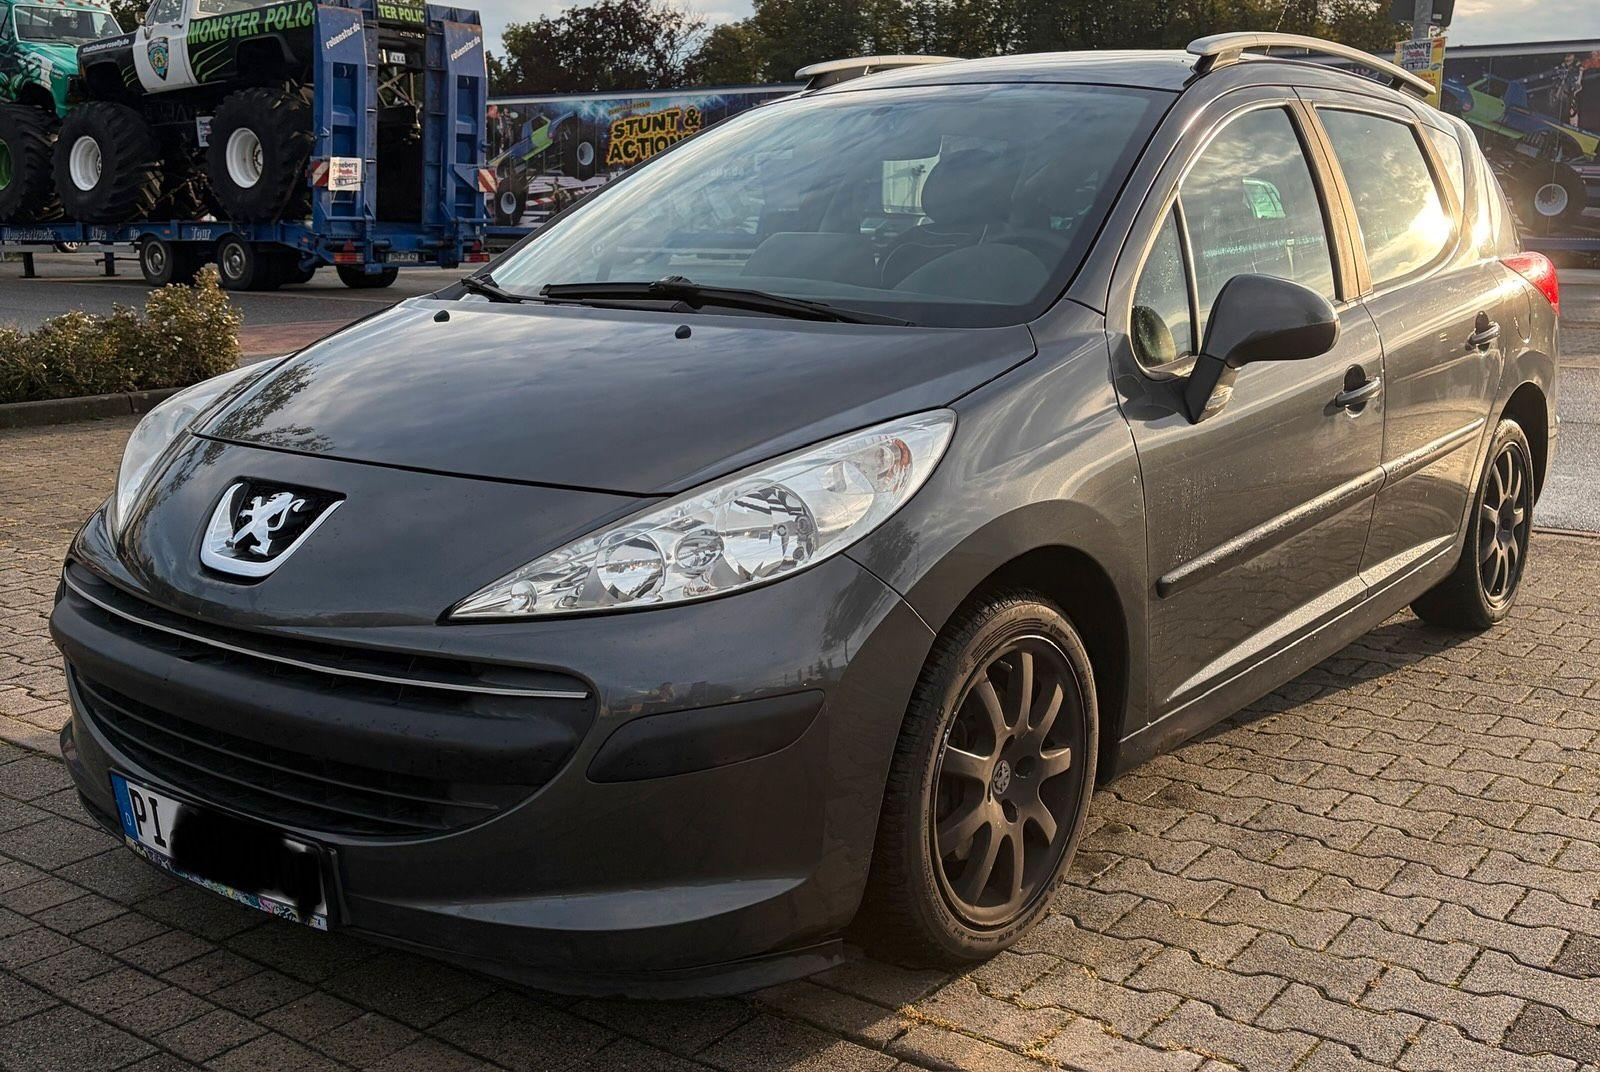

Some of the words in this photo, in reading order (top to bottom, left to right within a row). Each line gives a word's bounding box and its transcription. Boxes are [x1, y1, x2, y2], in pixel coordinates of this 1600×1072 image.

[187, 11, 259, 45] MONSTER
[265, 1, 316, 32] POLIC
[612, 110, 681, 140] STUNT
[683, 107, 700, 129] &
[608, 131, 696, 163] ACTION
[129, 787, 167, 849] PI
